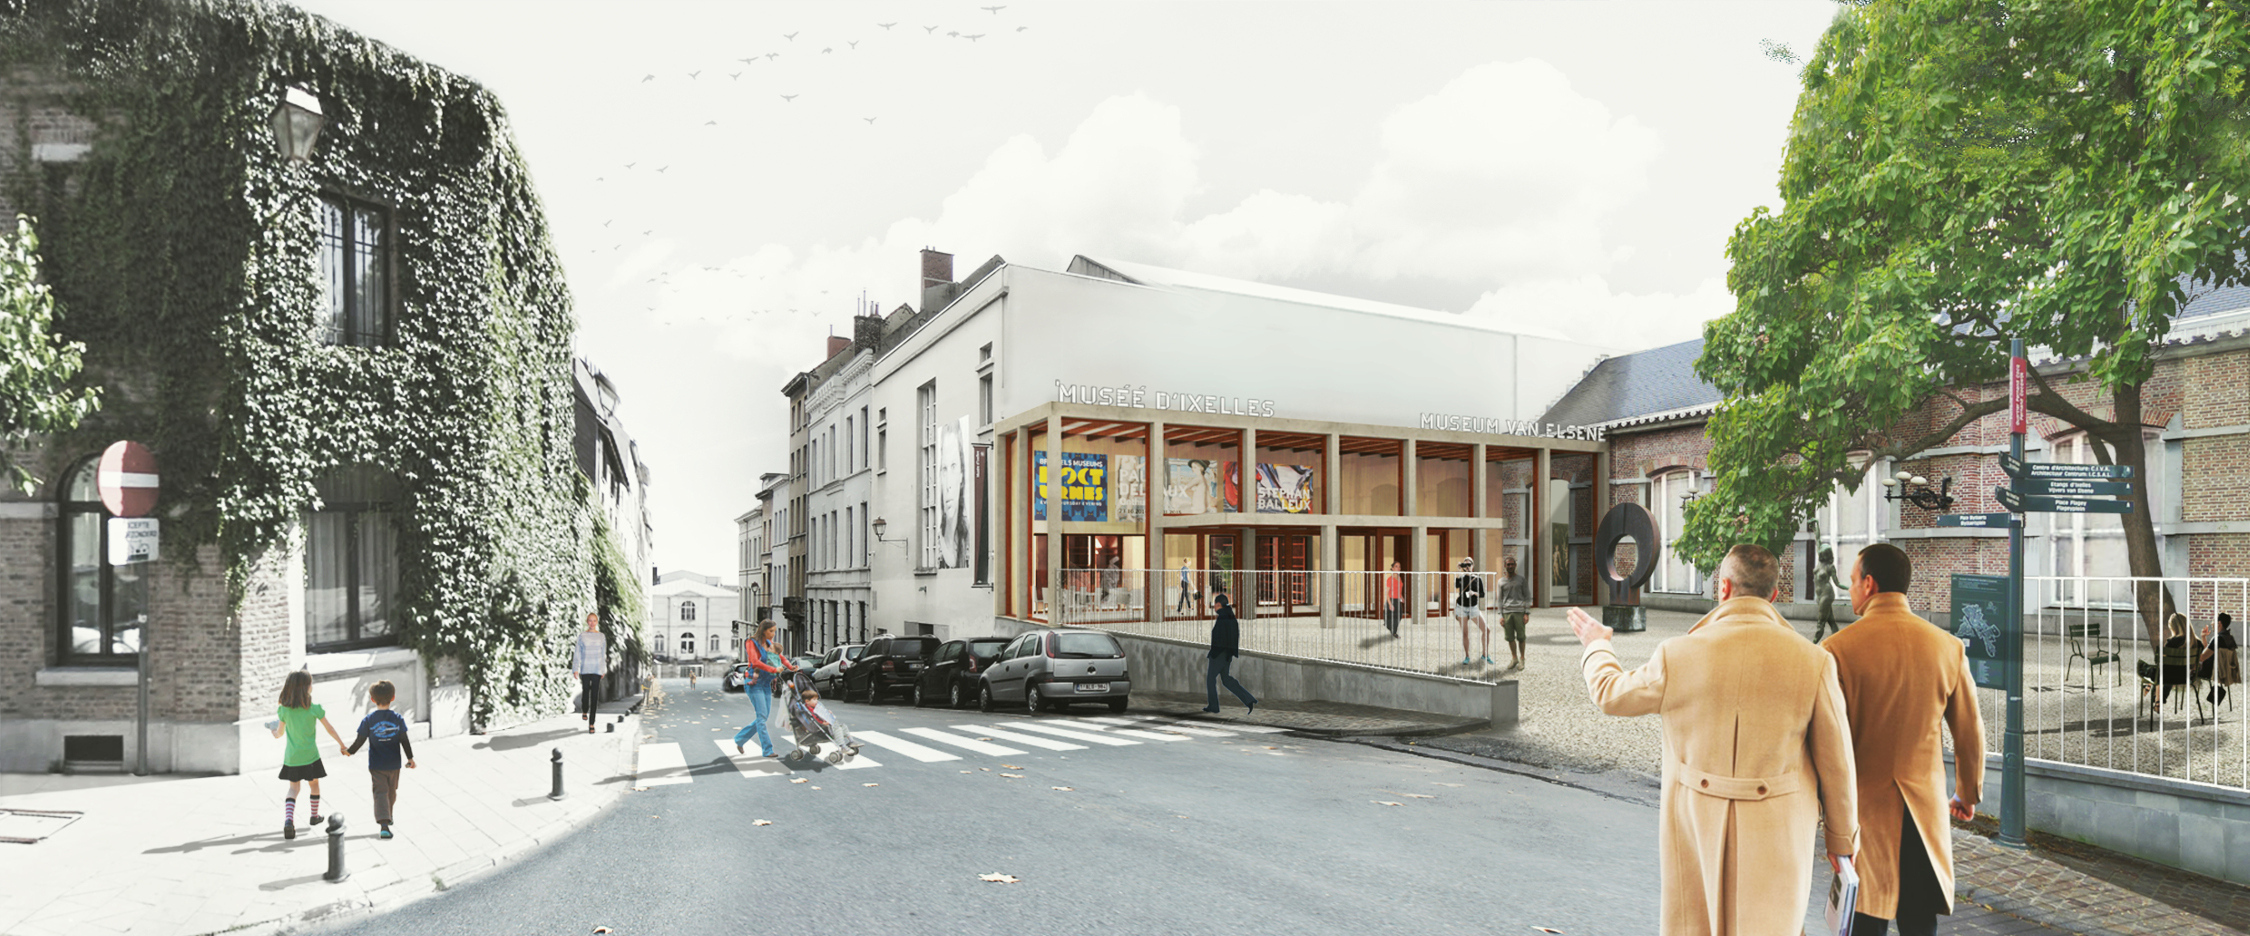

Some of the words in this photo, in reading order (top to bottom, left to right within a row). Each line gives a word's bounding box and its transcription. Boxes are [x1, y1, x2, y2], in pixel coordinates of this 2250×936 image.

[1156, 390, 1275, 418] D'IXELLES
[1420, 412, 1500, 434] MUSEUM
[1505, 419, 1539, 437] VAN
[1546, 423, 1607, 442] ELSENE
[1073, 459, 1103, 467] MUSEUMS
[1258, 487, 1310, 499] STEPHAN
[1258, 499, 1311, 510] BALLEUX
